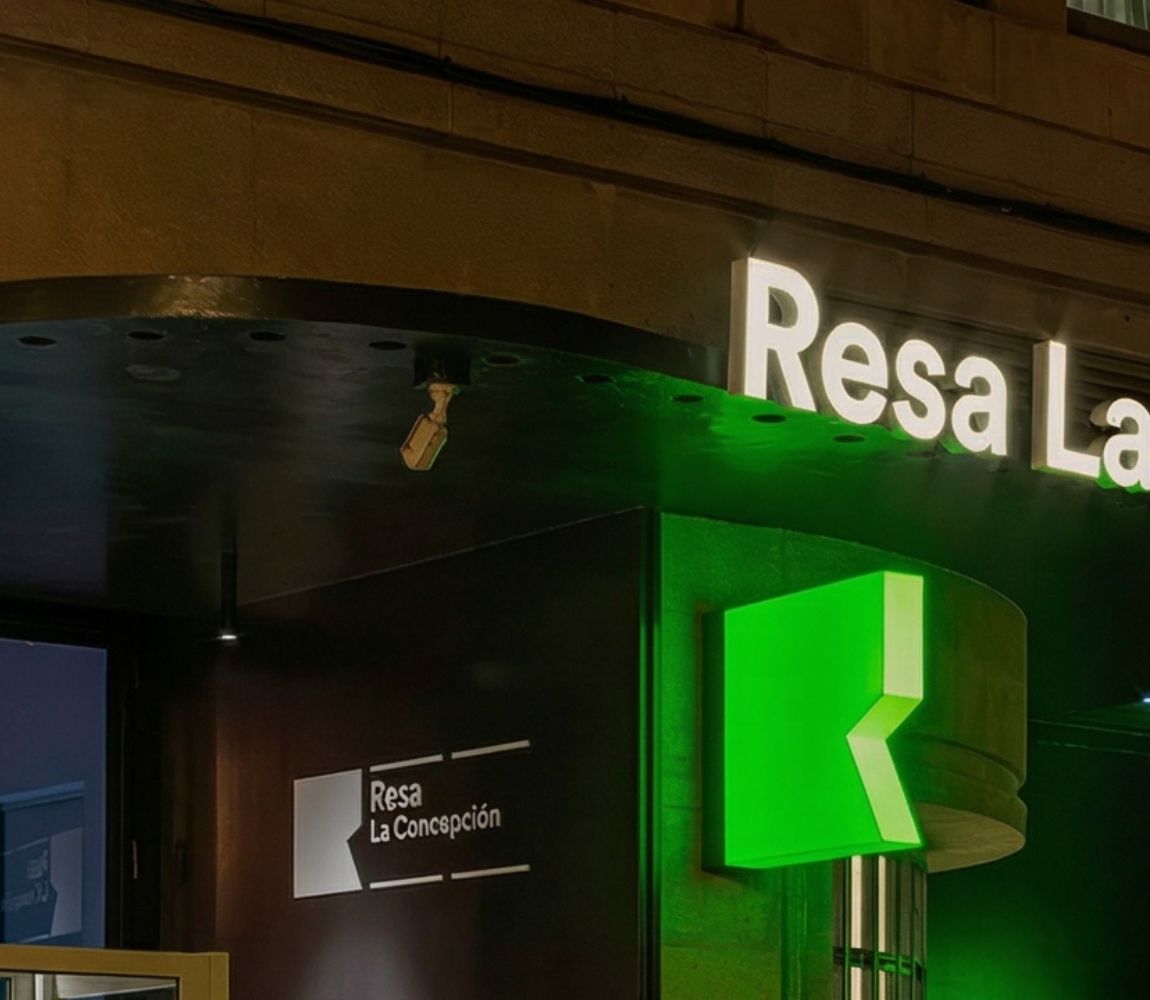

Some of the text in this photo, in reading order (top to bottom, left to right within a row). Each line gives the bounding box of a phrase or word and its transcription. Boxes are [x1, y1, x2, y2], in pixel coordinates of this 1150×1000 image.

[730, 257, 1007, 455] Resa
[370, 780, 422, 812] Resa
[370, 804, 501, 843] La Concepción
